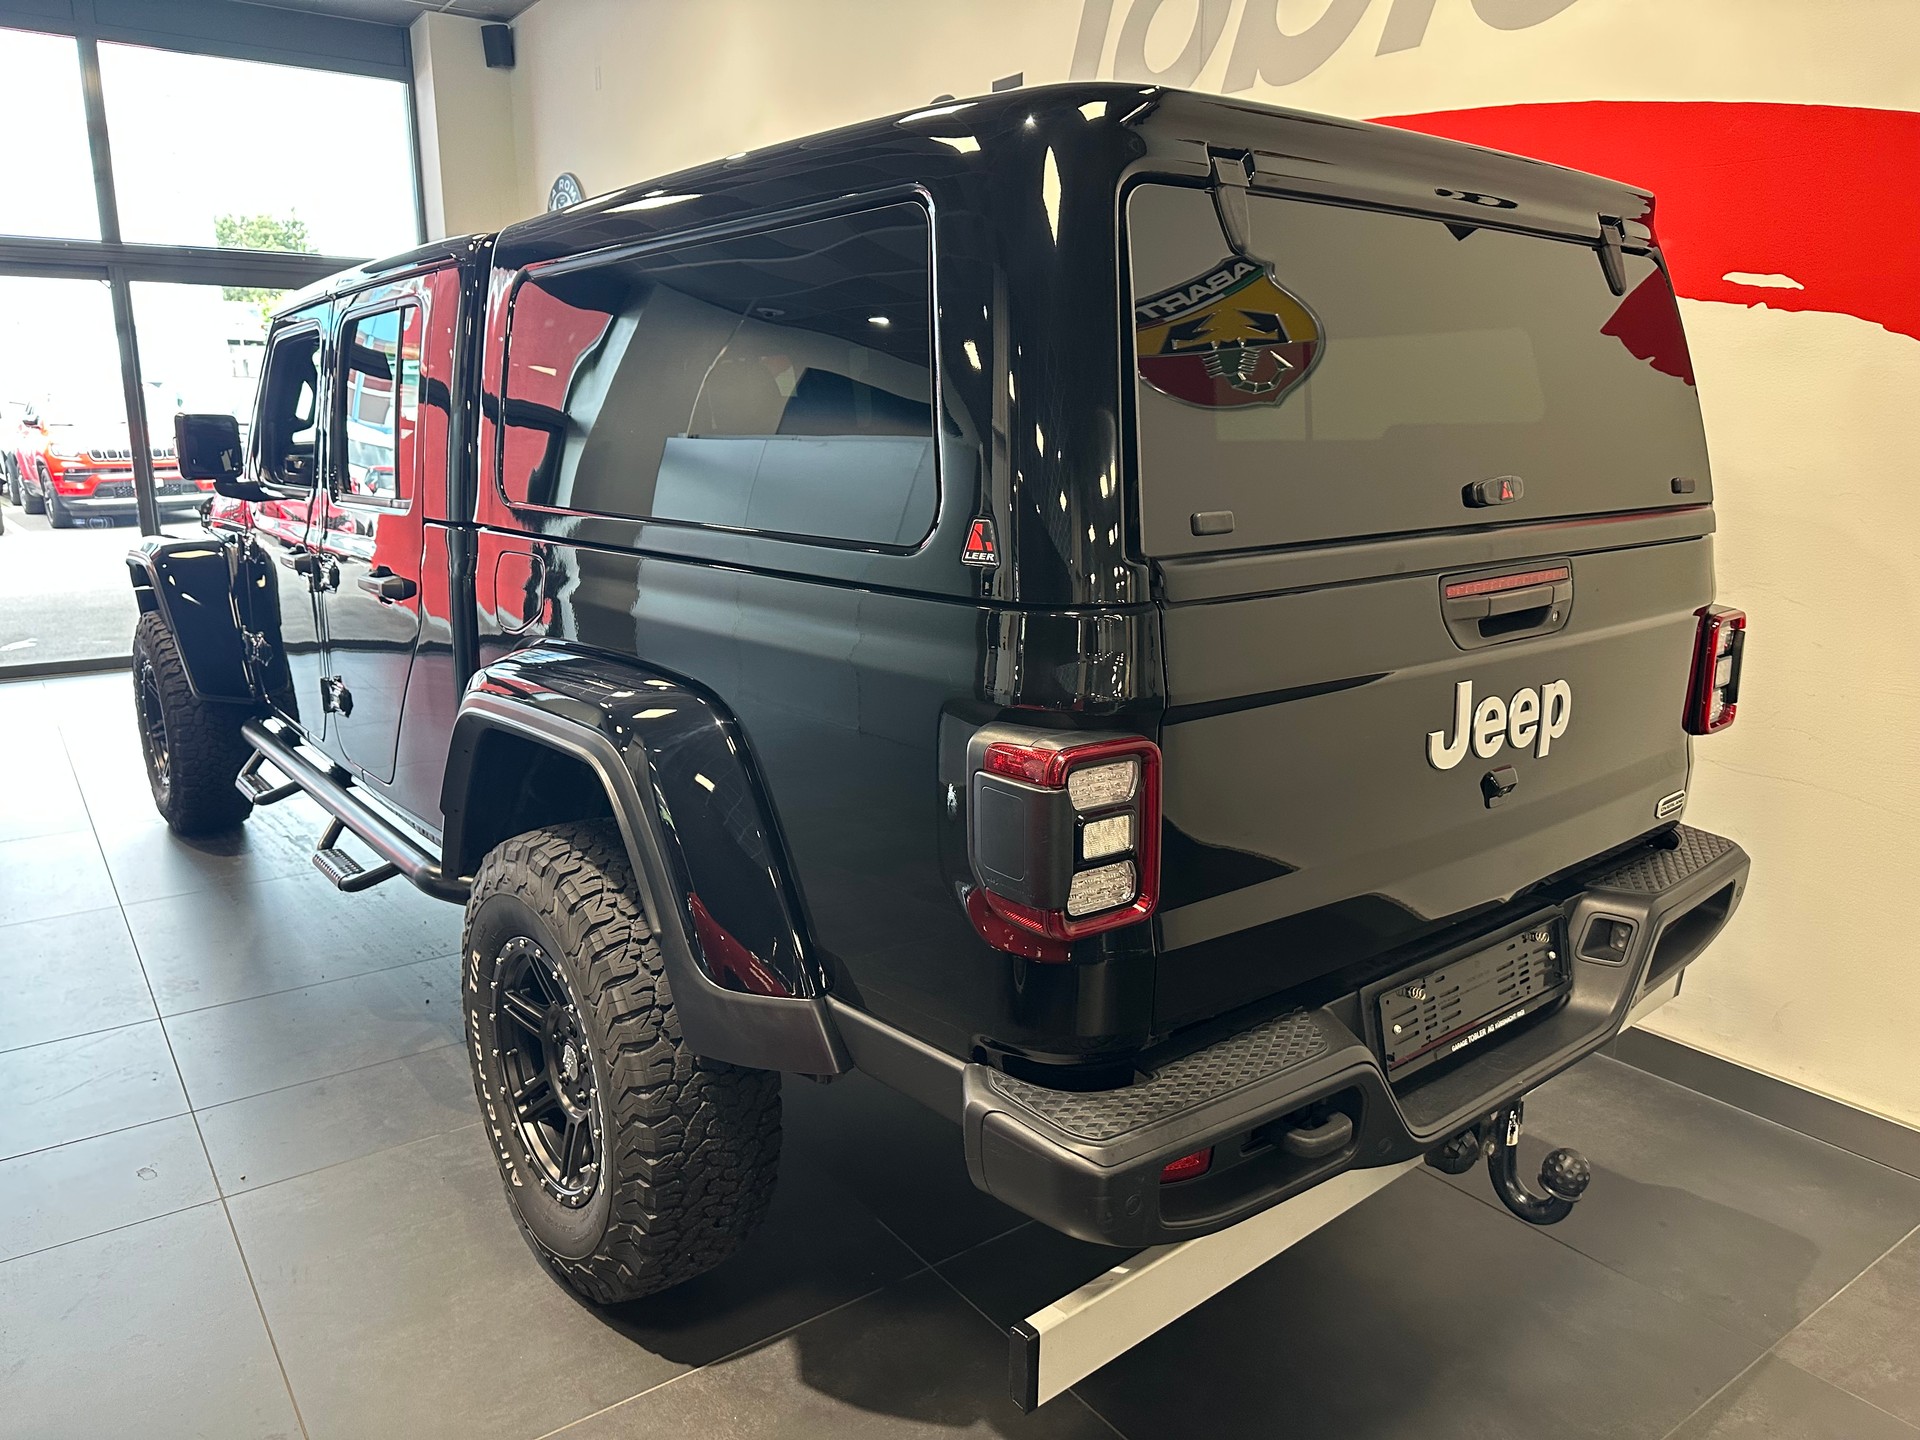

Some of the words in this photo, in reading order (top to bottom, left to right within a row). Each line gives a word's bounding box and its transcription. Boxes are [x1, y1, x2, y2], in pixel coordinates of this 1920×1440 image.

[558, 178, 578, 203] ROM
[965, 551, 995, 561] LEER
[1427, 678, 1572, 770] Jeep
[1660, 798, 1685, 811] OVERLAND
[469, 949, 482, 994] T/A
[1451, 1038, 1469, 1052] GARAGE
[1468, 1028, 1487, 1044] TOBLER
[1487, 1023, 1495, 1034] AG
[470, 1012, 523, 1188] All-Terrain
